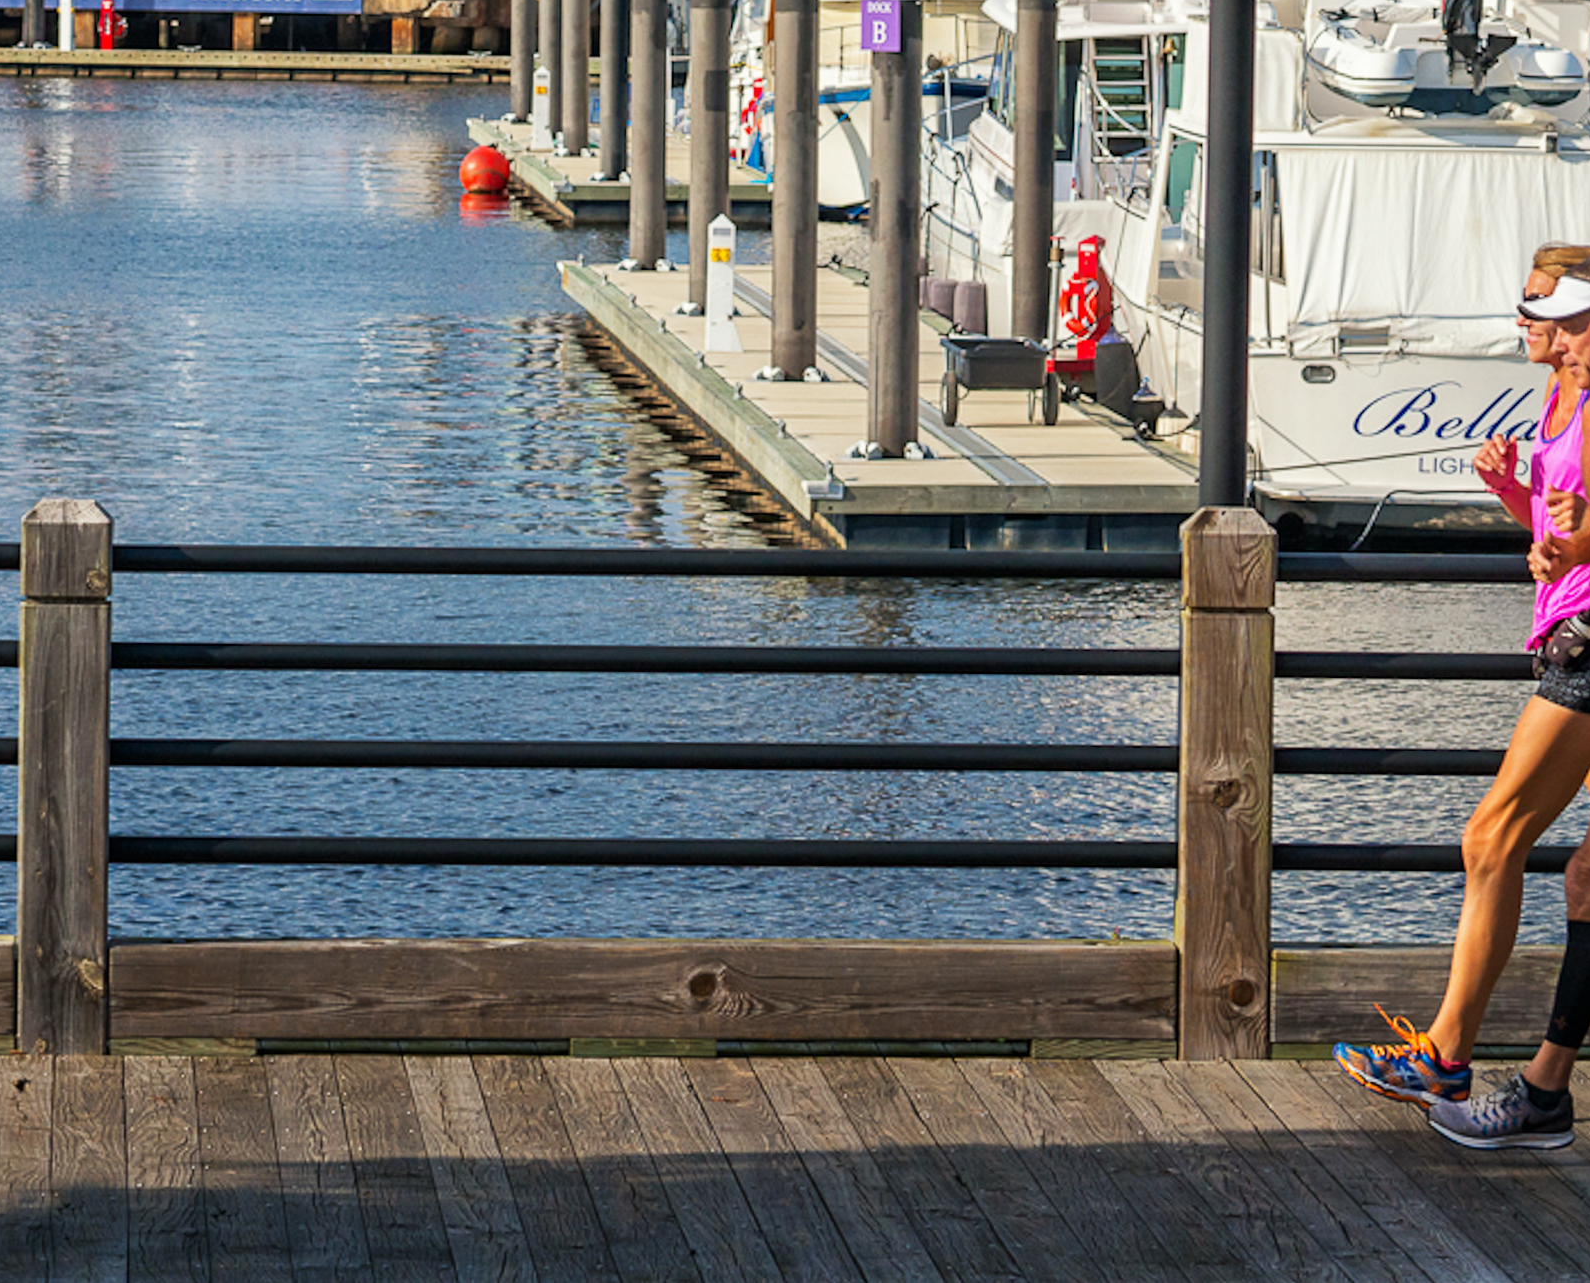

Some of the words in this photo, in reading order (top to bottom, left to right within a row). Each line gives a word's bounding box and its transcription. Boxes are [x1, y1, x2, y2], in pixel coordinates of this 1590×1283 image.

[867, 1, 892, 13] DOCK
[872, 20, 887, 43] B
[1352, 380, 1540, 440] Bella
